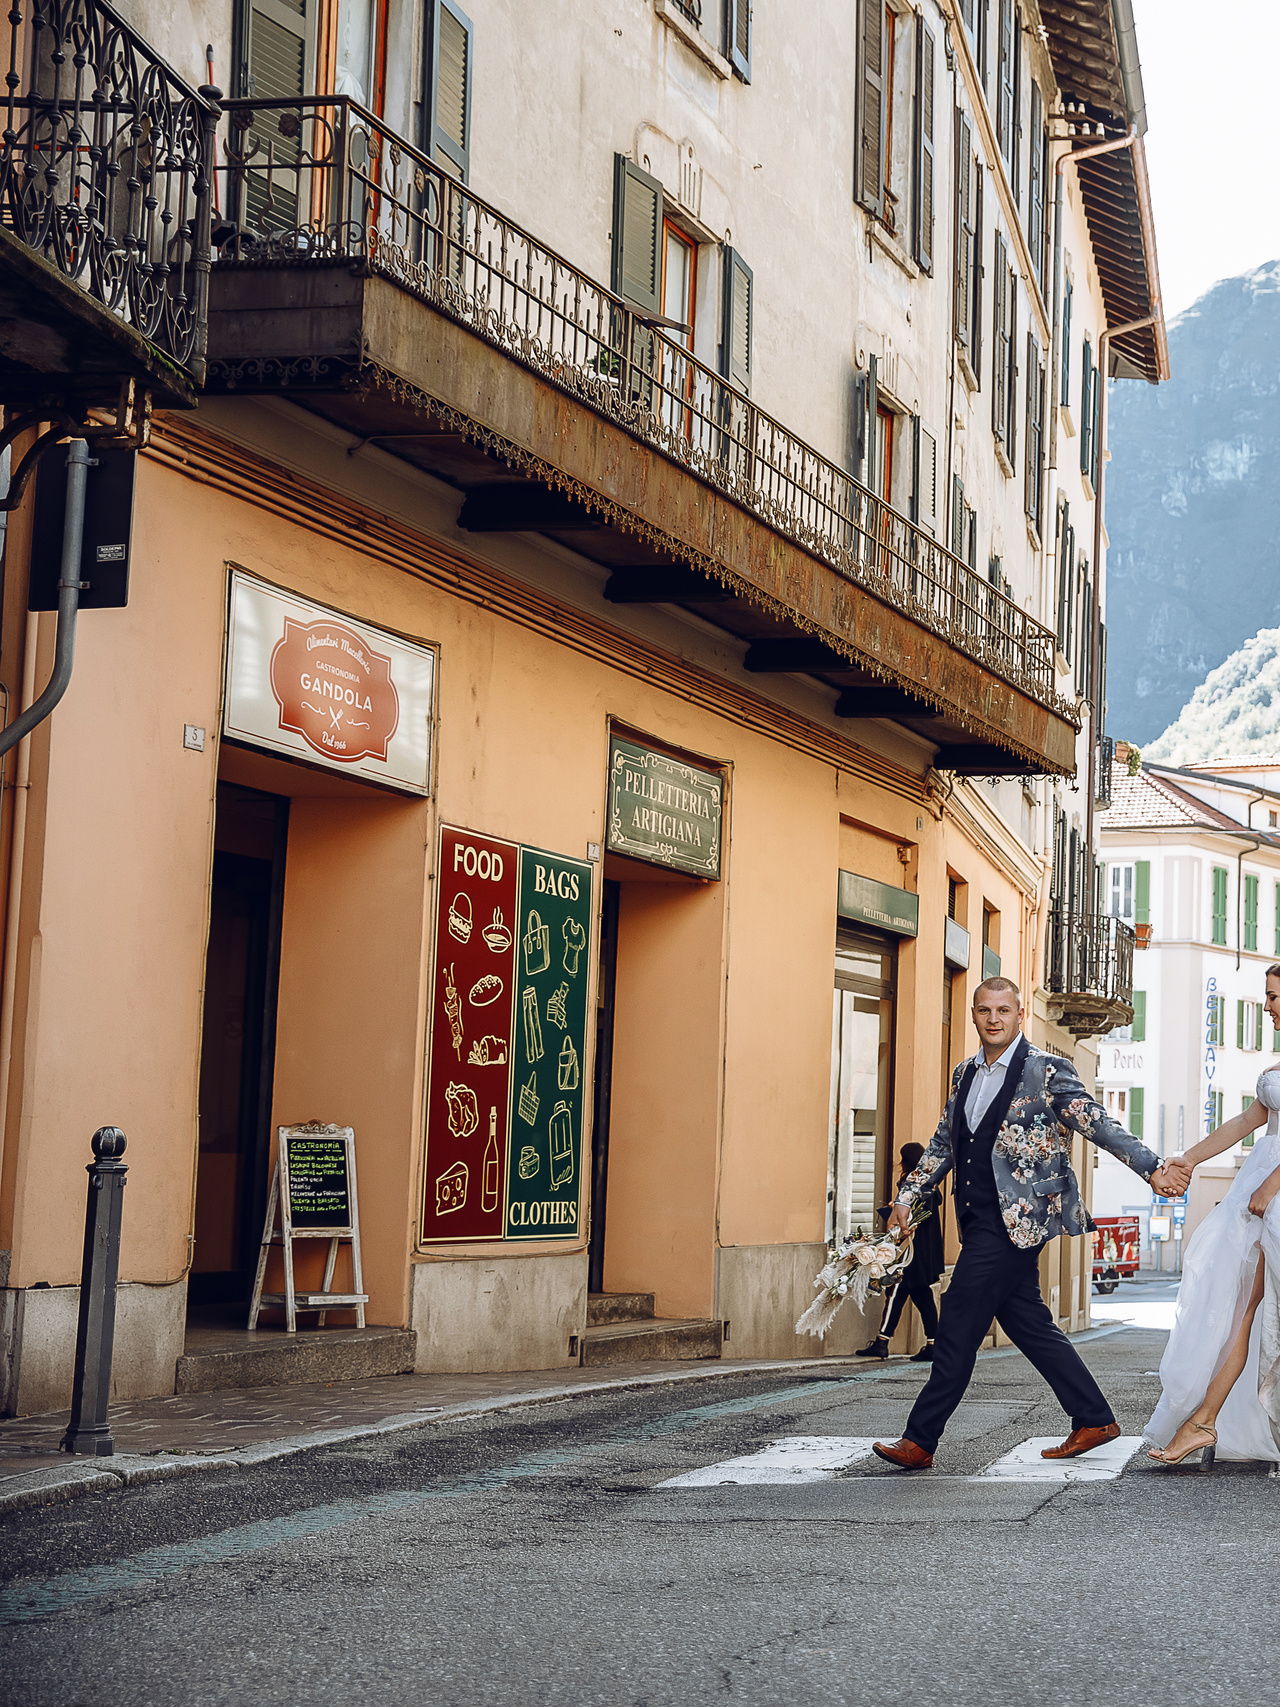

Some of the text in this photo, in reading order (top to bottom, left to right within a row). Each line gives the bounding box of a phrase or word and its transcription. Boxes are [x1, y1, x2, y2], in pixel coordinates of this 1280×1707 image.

[306, 633, 371, 675] Alimentari Macelleria
[315, 660, 361, 684] GASTRONOMIA
[300, 673, 373, 712] GANDOLA
[192, 728, 198, 741] 5
[321, 730, 347, 750] Dal 1966
[624, 769, 710, 819] PELLETTERIA
[631, 805, 702, 847] ARTIGIANA
[453, 843, 504, 882] FOOD
[534, 864, 580, 901] BAGS
[863, 906, 915, 931] PELLETTERIA ARTIGIANA
[1113, 1048, 1144, 1069] Porto
[1203, 976, 1218, 1136] BELLAVIST
[290, 1141, 340, 1149] GASTRONOMIA
